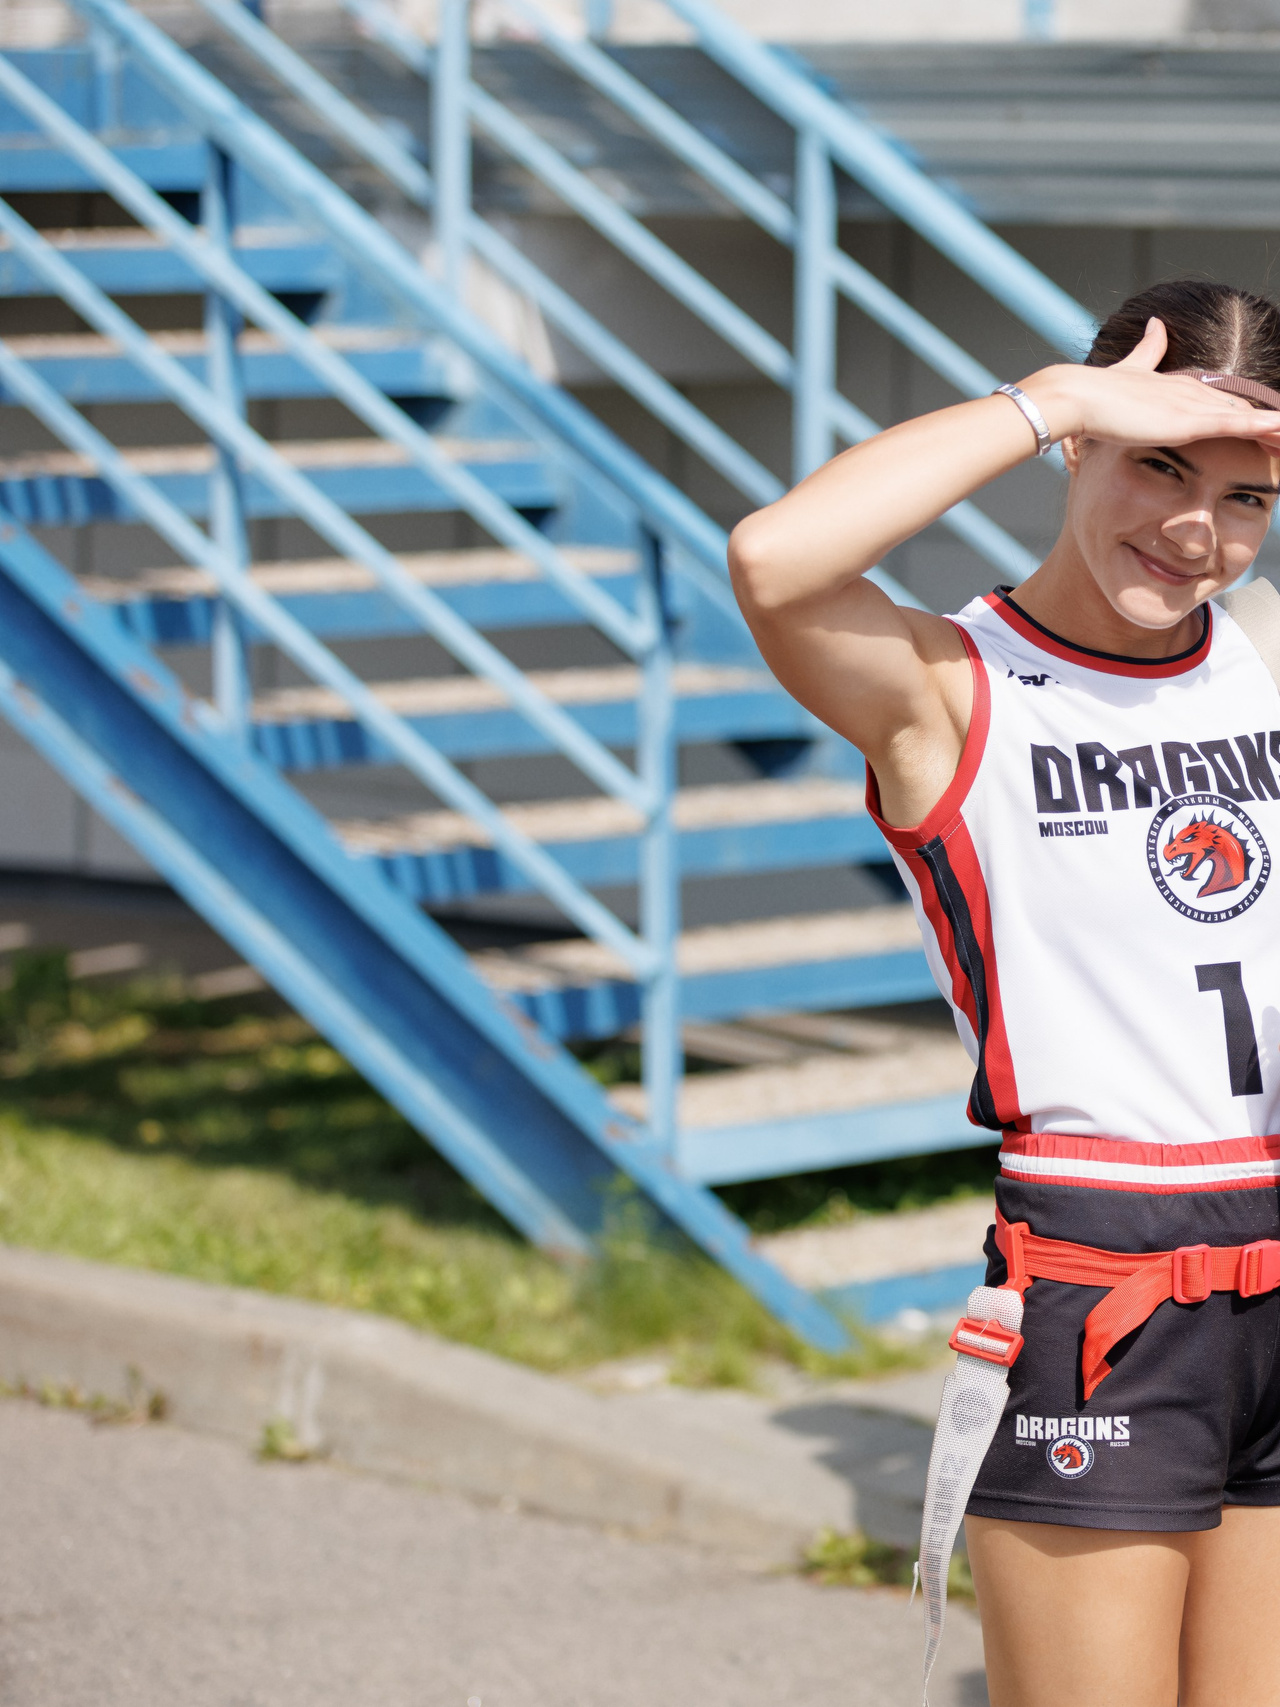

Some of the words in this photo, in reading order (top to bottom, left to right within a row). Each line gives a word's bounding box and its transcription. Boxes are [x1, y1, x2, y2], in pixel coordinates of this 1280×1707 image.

[1038, 820, 1109, 837] MOSCOW
[1149, 816, 1163, 869] ФУТБОЛА
[1238, 812, 1270, 884] МОСКОВСКИЙ
[1238, 888, 1260, 911] КЛУБ
[1194, 961, 1264, 1097] 1
[1016, 1414, 1130, 1440] DRAGONS
